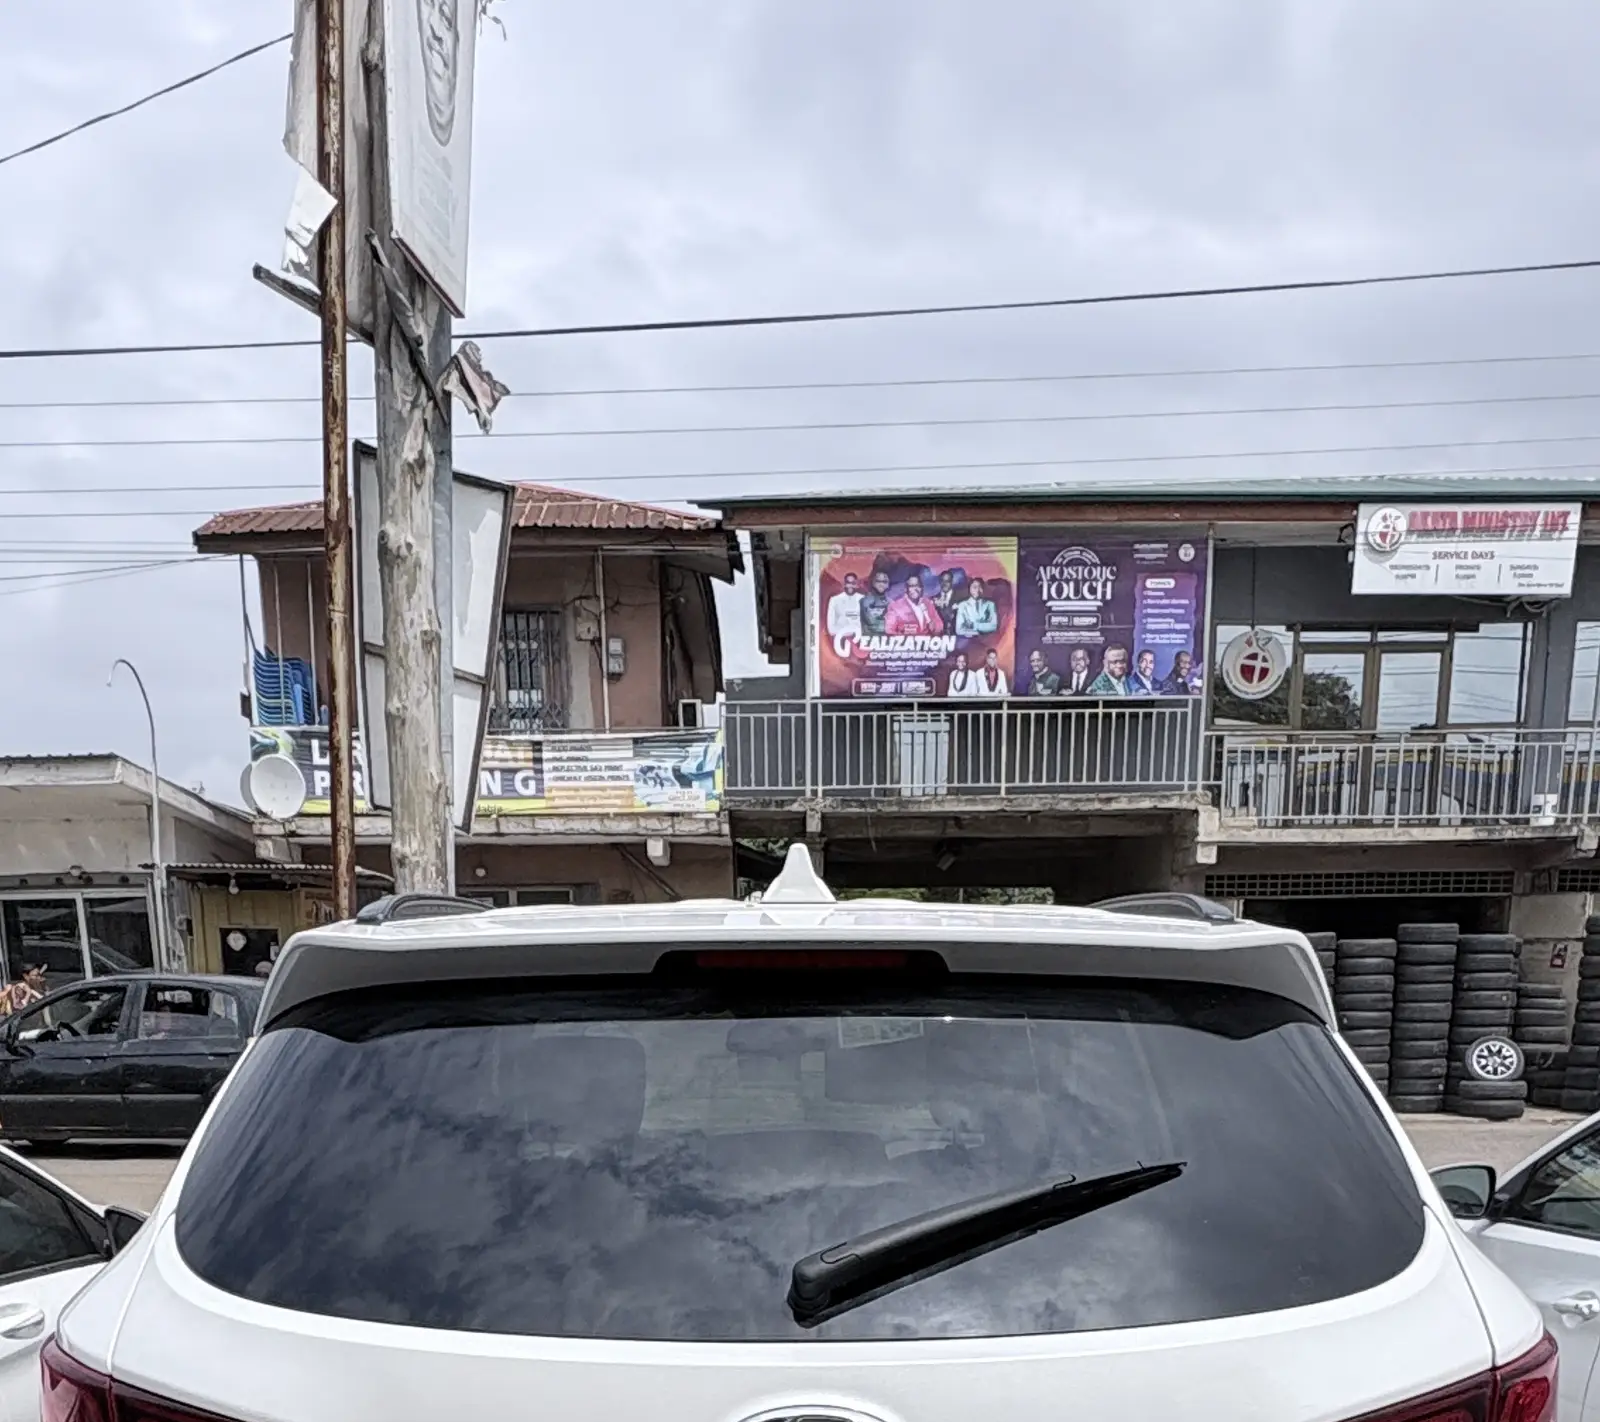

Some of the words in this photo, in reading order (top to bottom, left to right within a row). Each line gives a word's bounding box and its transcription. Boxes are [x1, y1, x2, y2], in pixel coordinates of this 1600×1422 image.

[1432, 550, 1468, 560] SERVICE
[1471, 550, 1495, 560] DAYS
[1037, 580, 1112, 600] TOUCH
